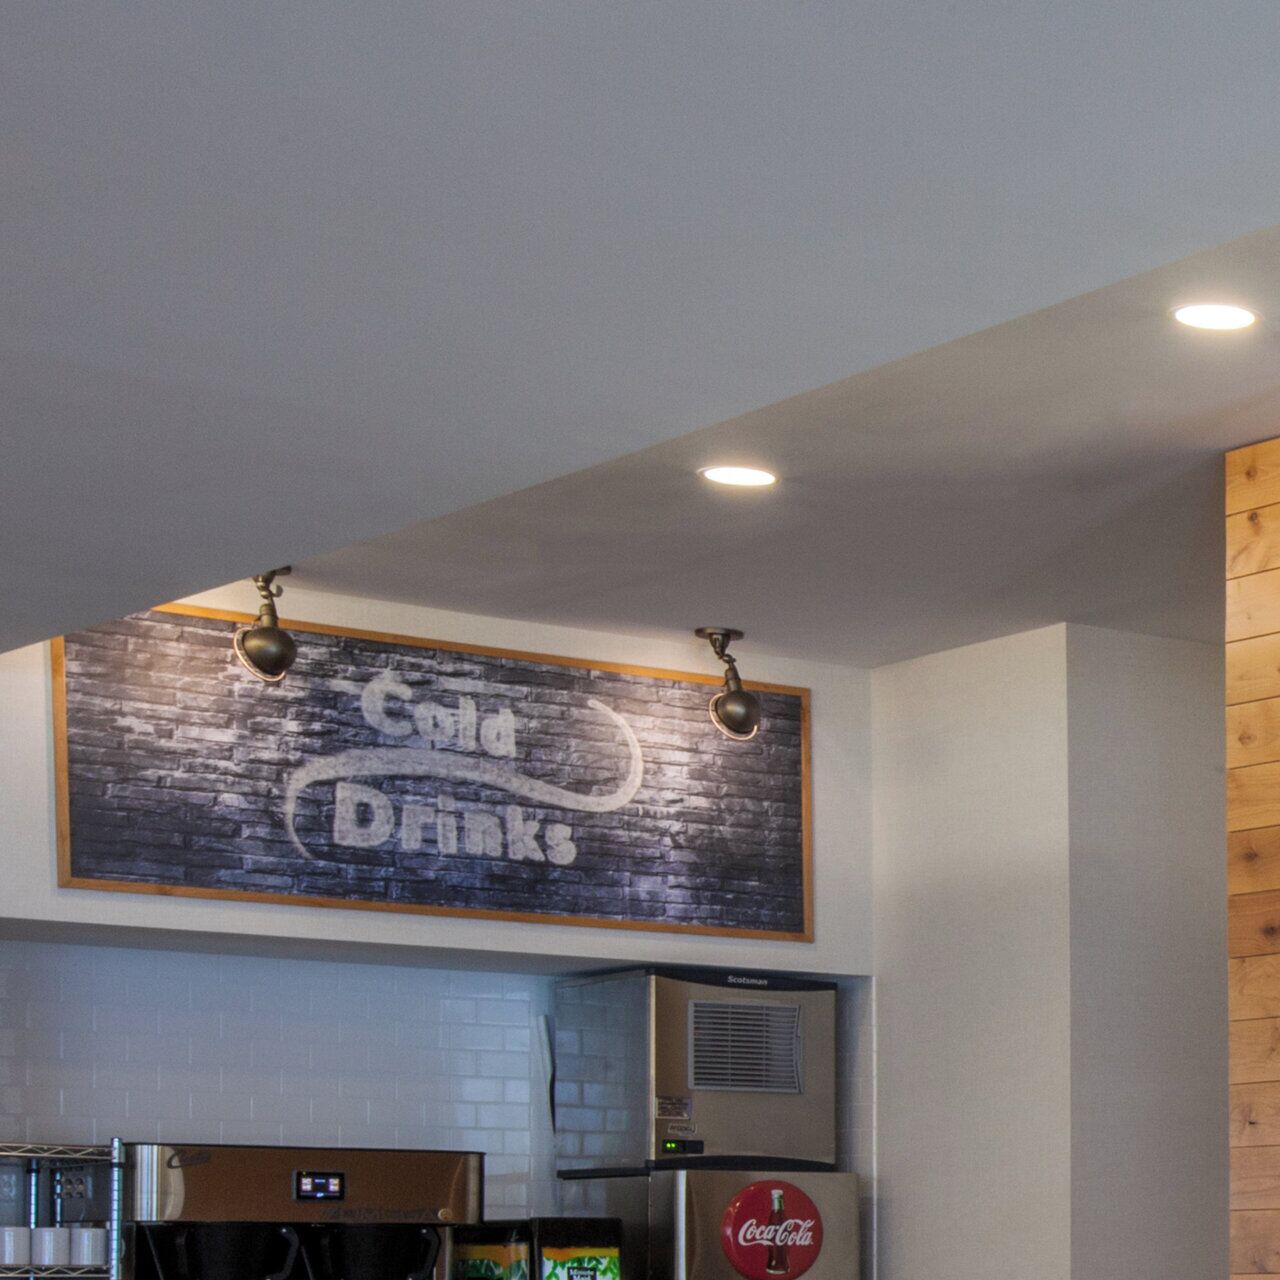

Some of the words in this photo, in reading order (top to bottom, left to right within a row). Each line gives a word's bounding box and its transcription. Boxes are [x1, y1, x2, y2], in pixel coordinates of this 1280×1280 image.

[360, 670, 516, 757] Cold
[333, 781, 577, 865] Drinks
[727, 974, 768, 985] Scotsman
[738, 1219, 815, 1246] Coca-Cola
